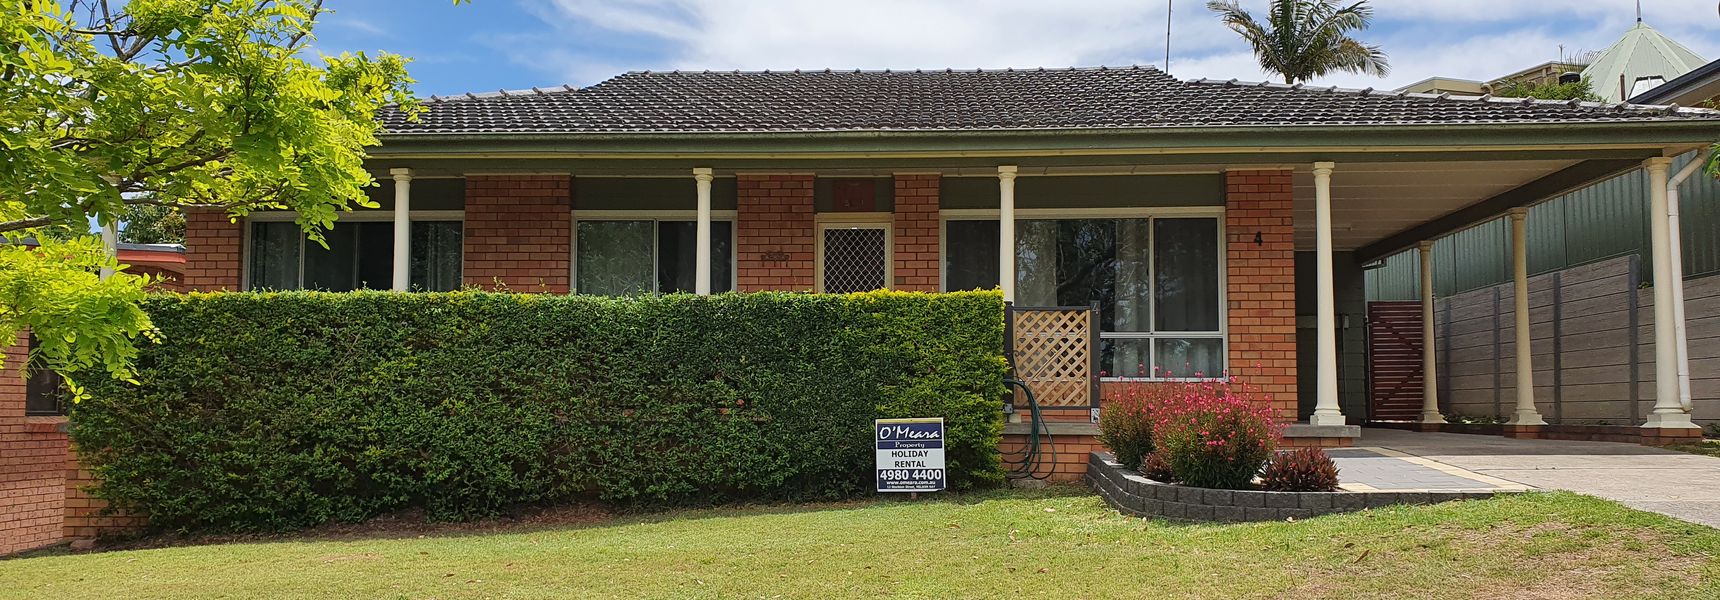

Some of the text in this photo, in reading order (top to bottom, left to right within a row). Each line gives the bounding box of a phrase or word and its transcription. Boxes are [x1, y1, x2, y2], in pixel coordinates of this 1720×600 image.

[1254, 231, 1263, 246] 4
[879, 425, 940, 439] O'Meara
[895, 441, 925, 449] Property
[891, 450, 929, 458] HOLIDAY
[894, 460, 927, 468] RENTAL
[880, 469, 942, 480] 4980 4400
